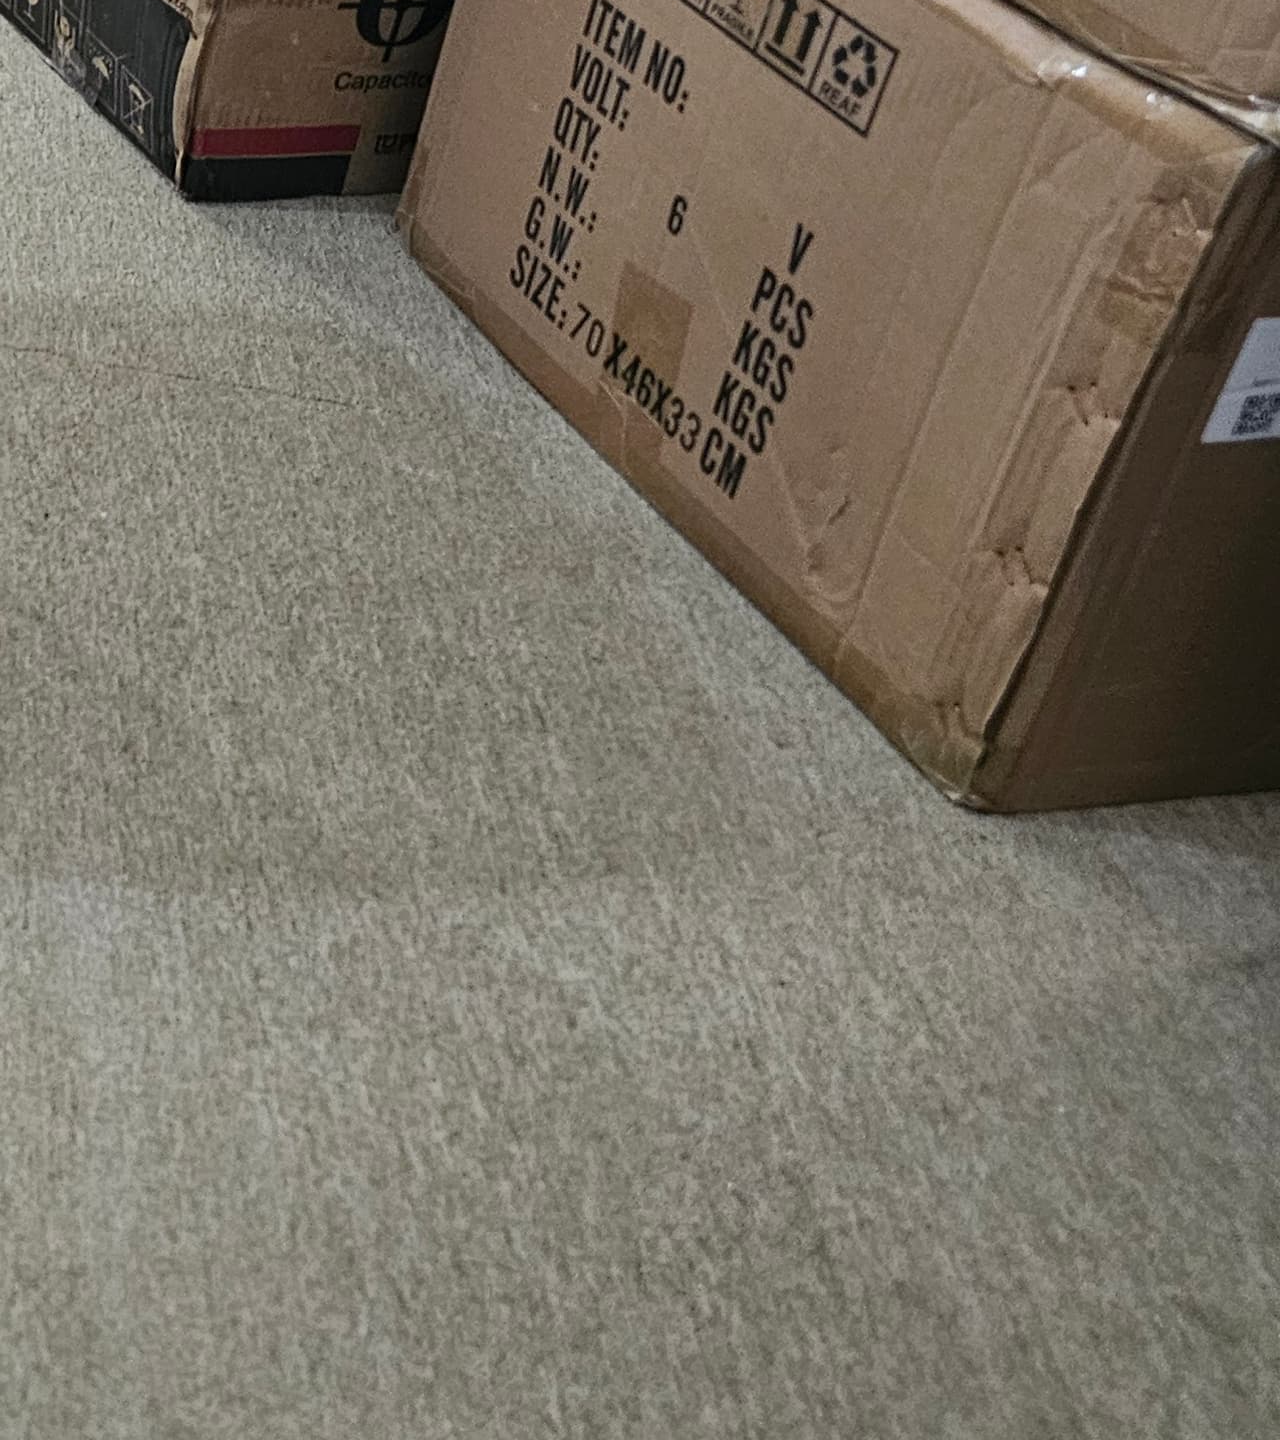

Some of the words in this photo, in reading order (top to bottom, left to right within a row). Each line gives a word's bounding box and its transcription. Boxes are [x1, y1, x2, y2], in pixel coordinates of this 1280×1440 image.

[570, 44, 632, 132] VOLT:
[646, 37, 690, 116] NO:
[553, 97, 601, 171] QTY:
[668, 193, 689, 237] 6
[788, 223, 815, 277] V
[750, 267, 814, 351] PCS
[732, 319, 795, 405] KGS
[713, 371, 776, 457] KGS
[699, 420, 747, 500] CM
